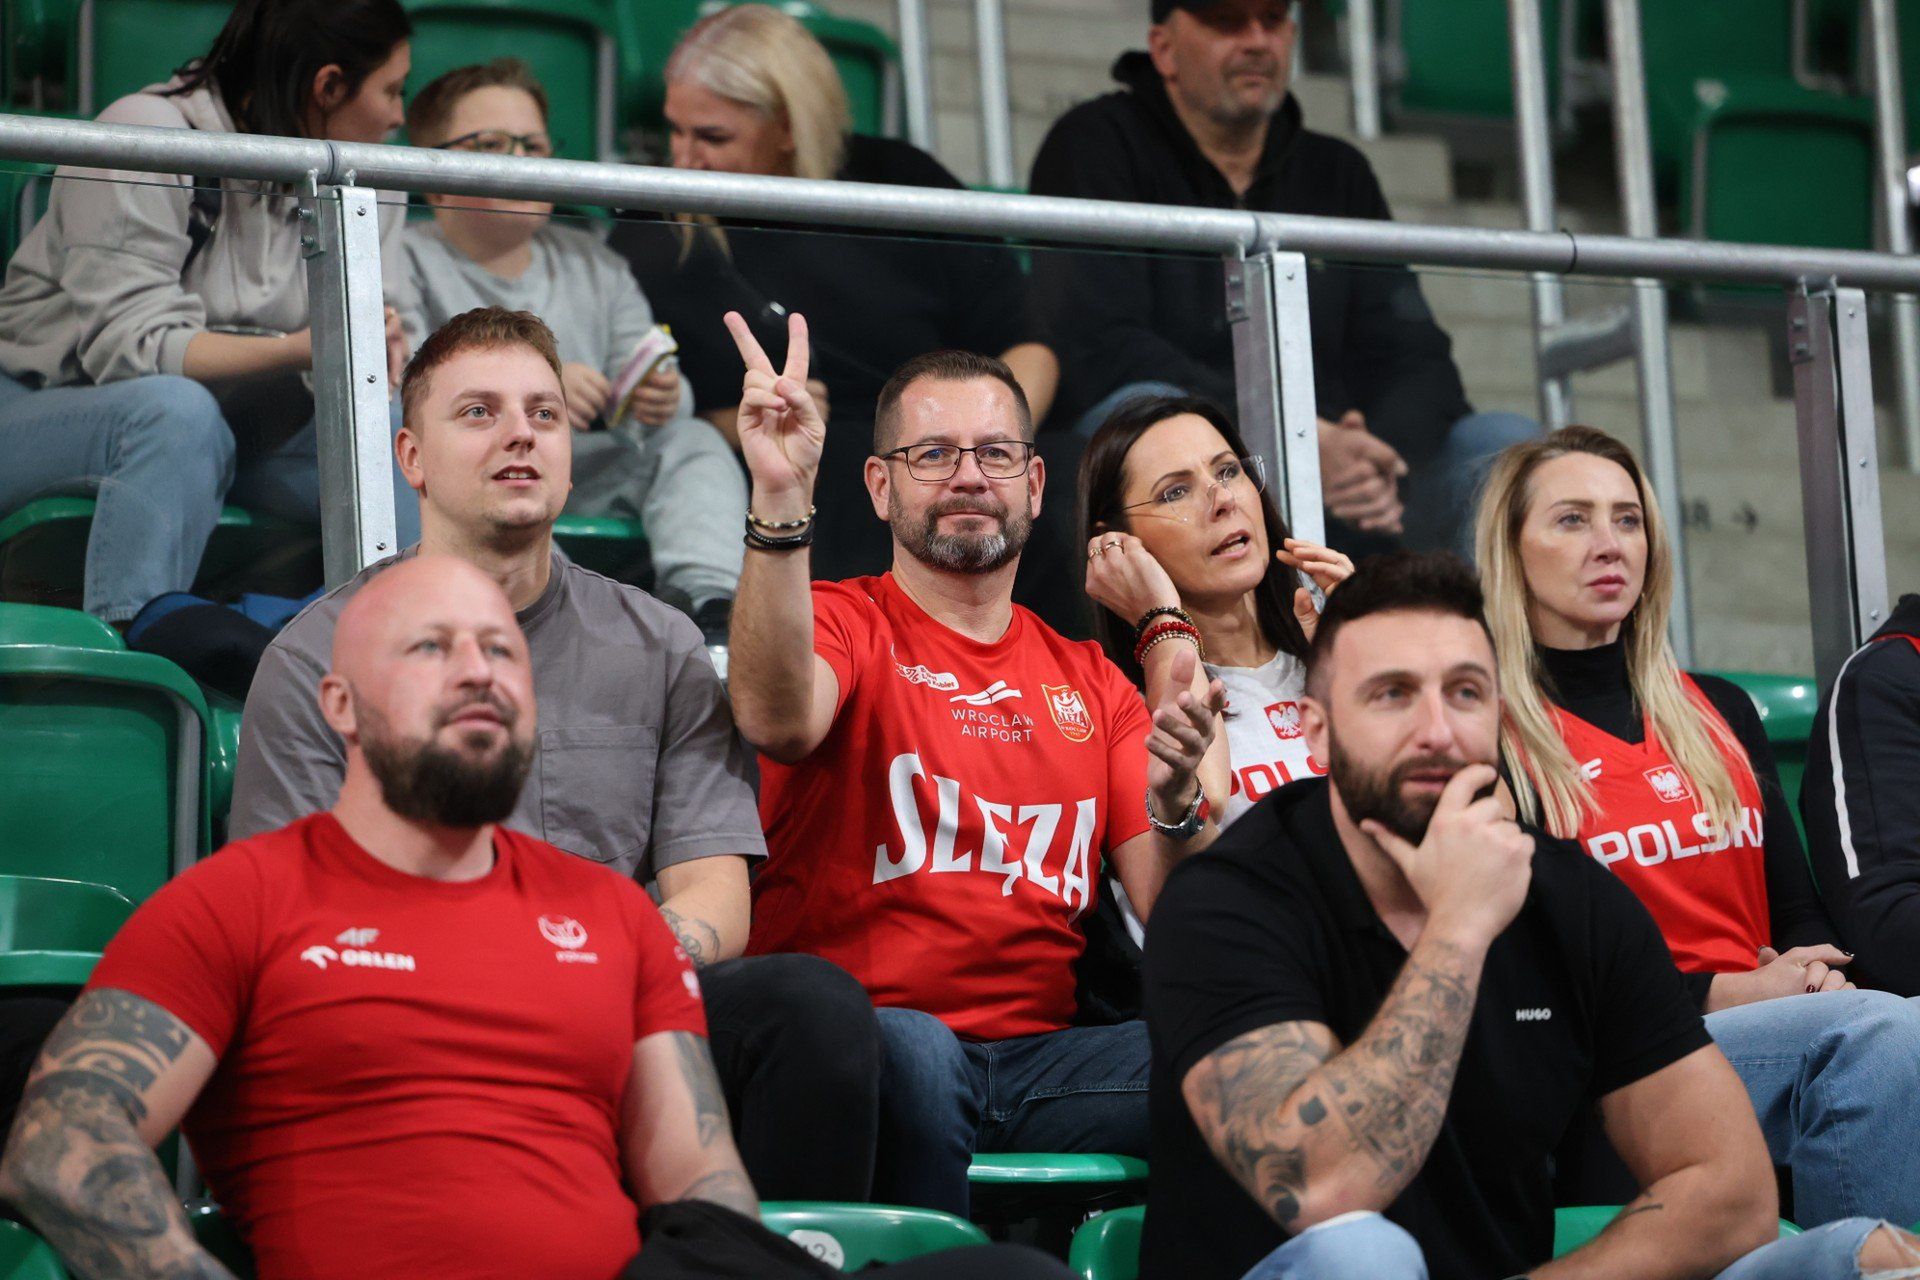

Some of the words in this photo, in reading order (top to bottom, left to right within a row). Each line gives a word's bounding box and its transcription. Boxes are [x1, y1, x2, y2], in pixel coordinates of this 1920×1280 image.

[950, 708, 1034, 728] WROCLAW
[961, 724, 1033, 743] AIRPORT
[340, 949, 416, 972] ORLEN
[1515, 1007, 1552, 1022] HUGO
